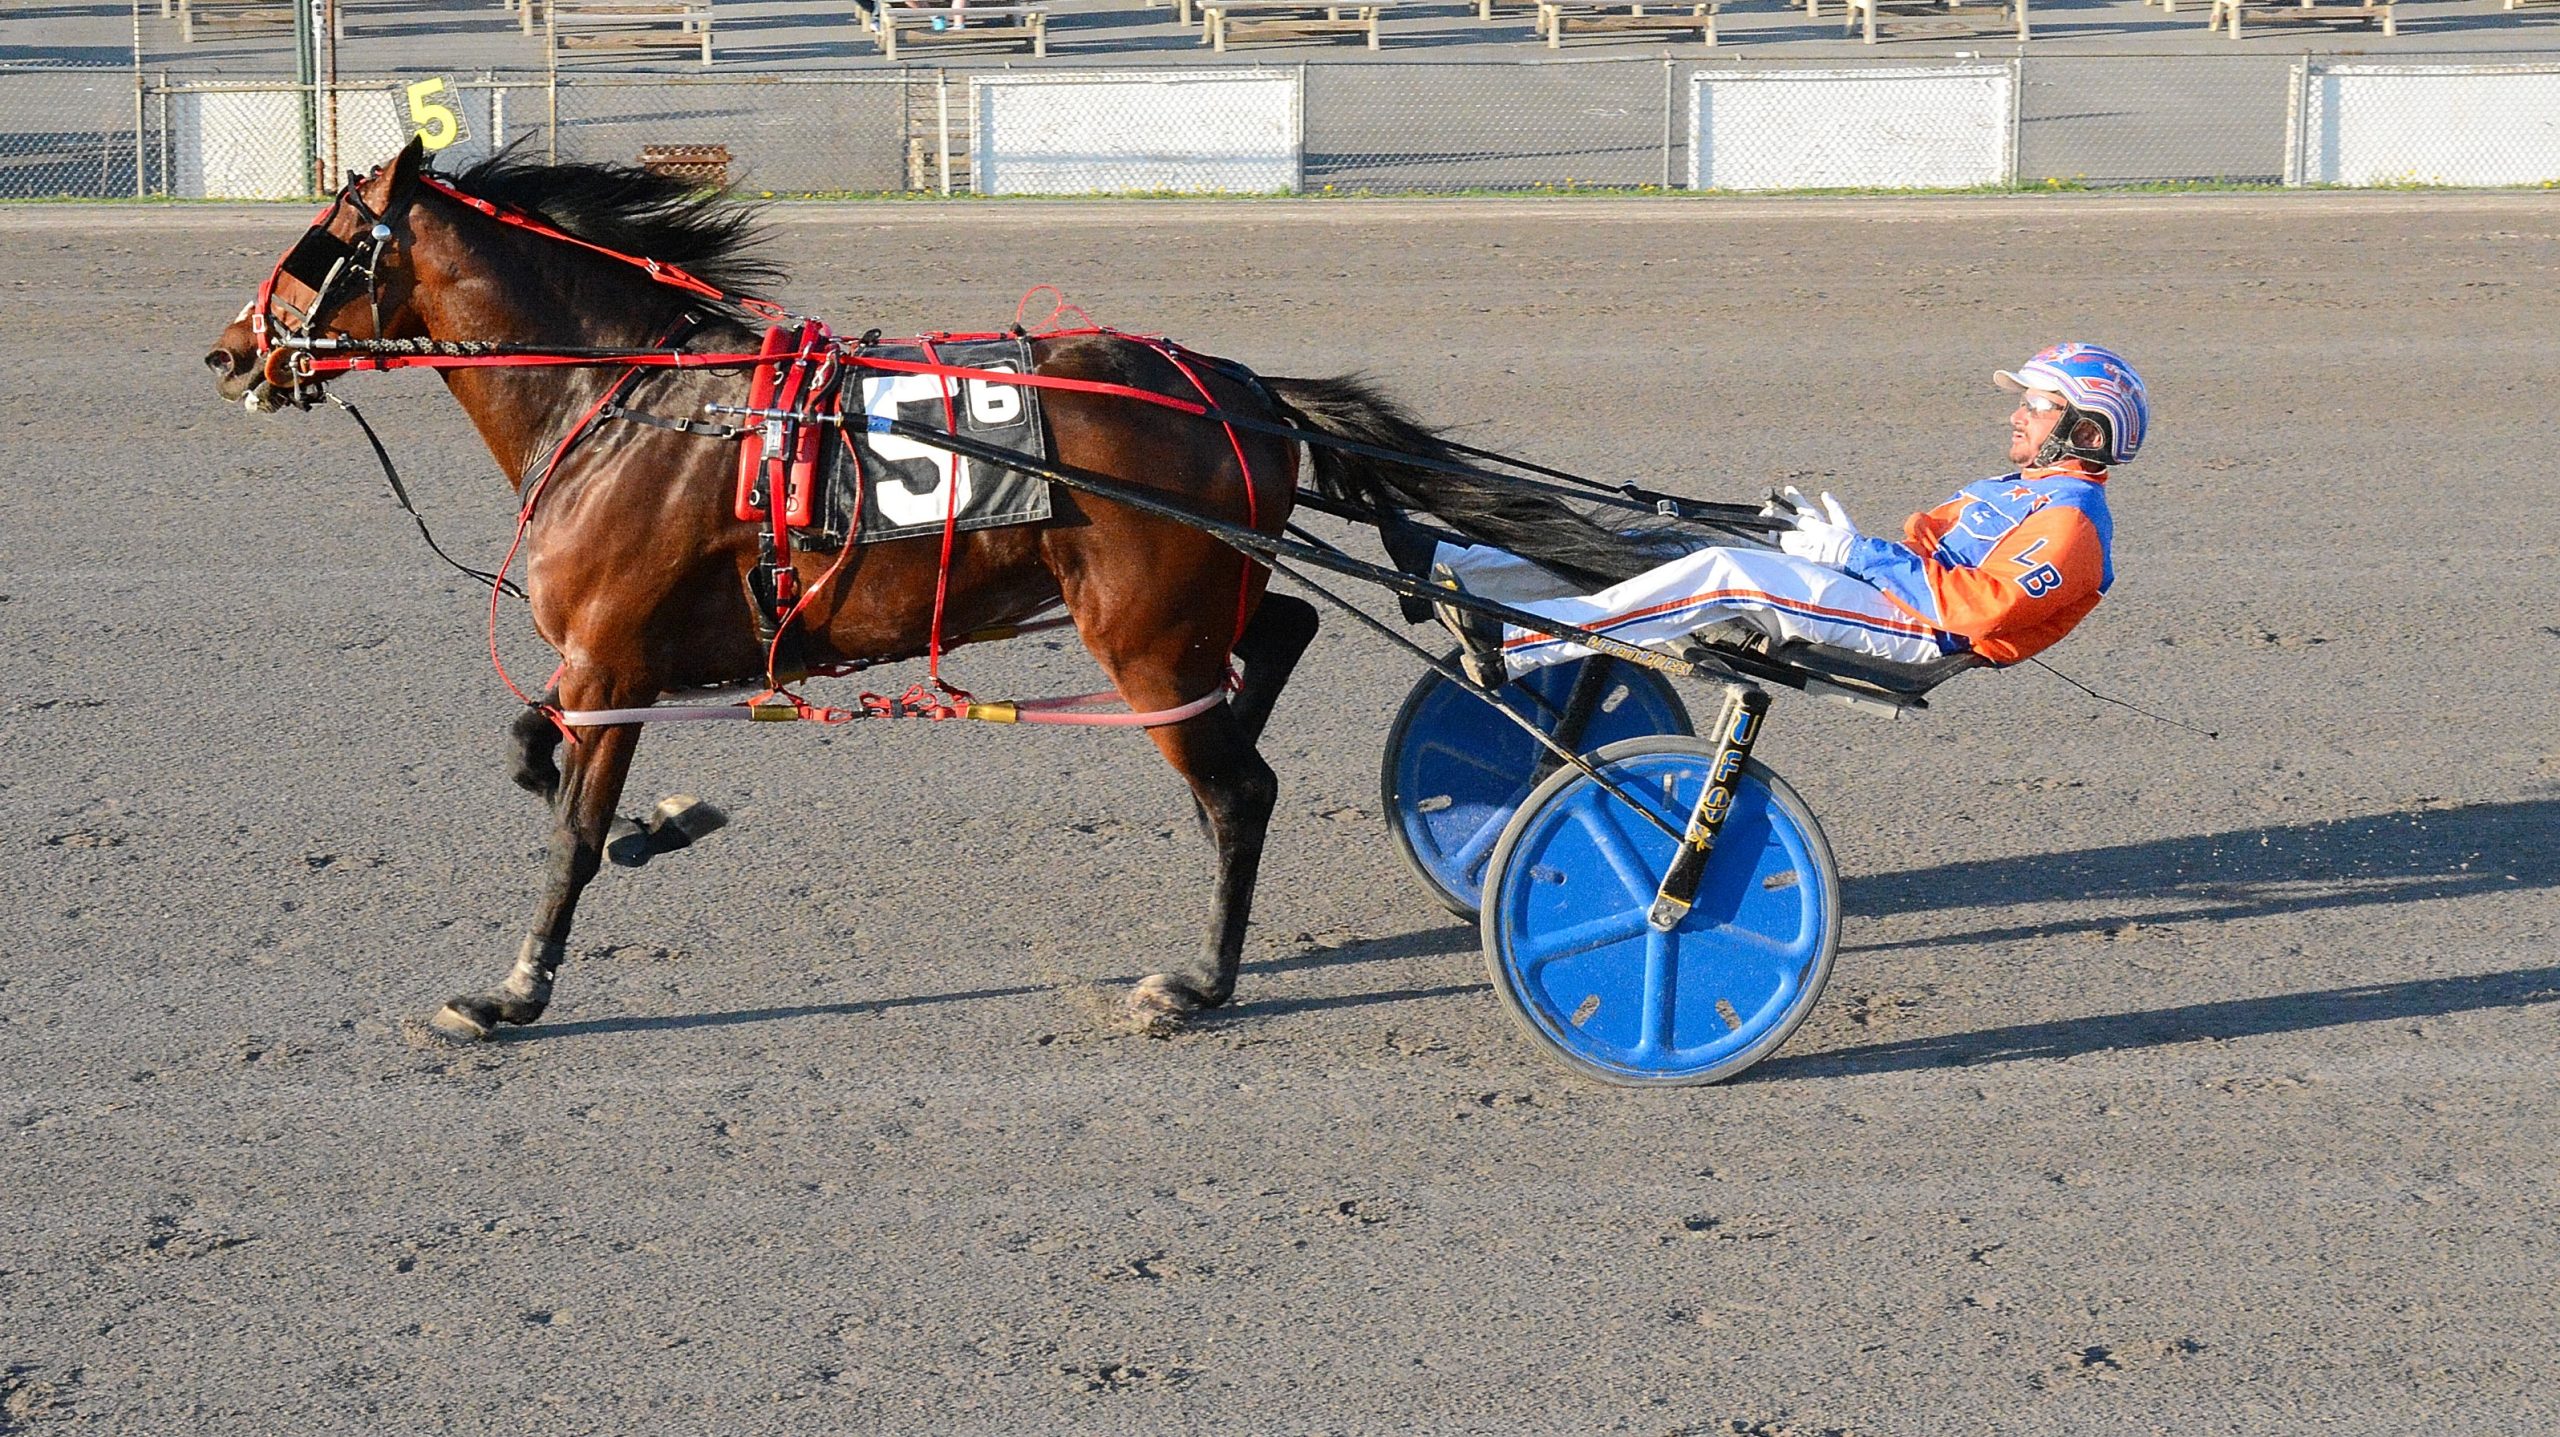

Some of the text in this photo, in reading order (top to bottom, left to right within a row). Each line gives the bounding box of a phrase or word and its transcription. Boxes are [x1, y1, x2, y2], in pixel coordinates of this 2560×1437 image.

[407, 77, 458, 150] 5
[969, 366, 1021, 424] 6
[862, 374, 972, 527] 5
[2009, 537, 2063, 598] LB
